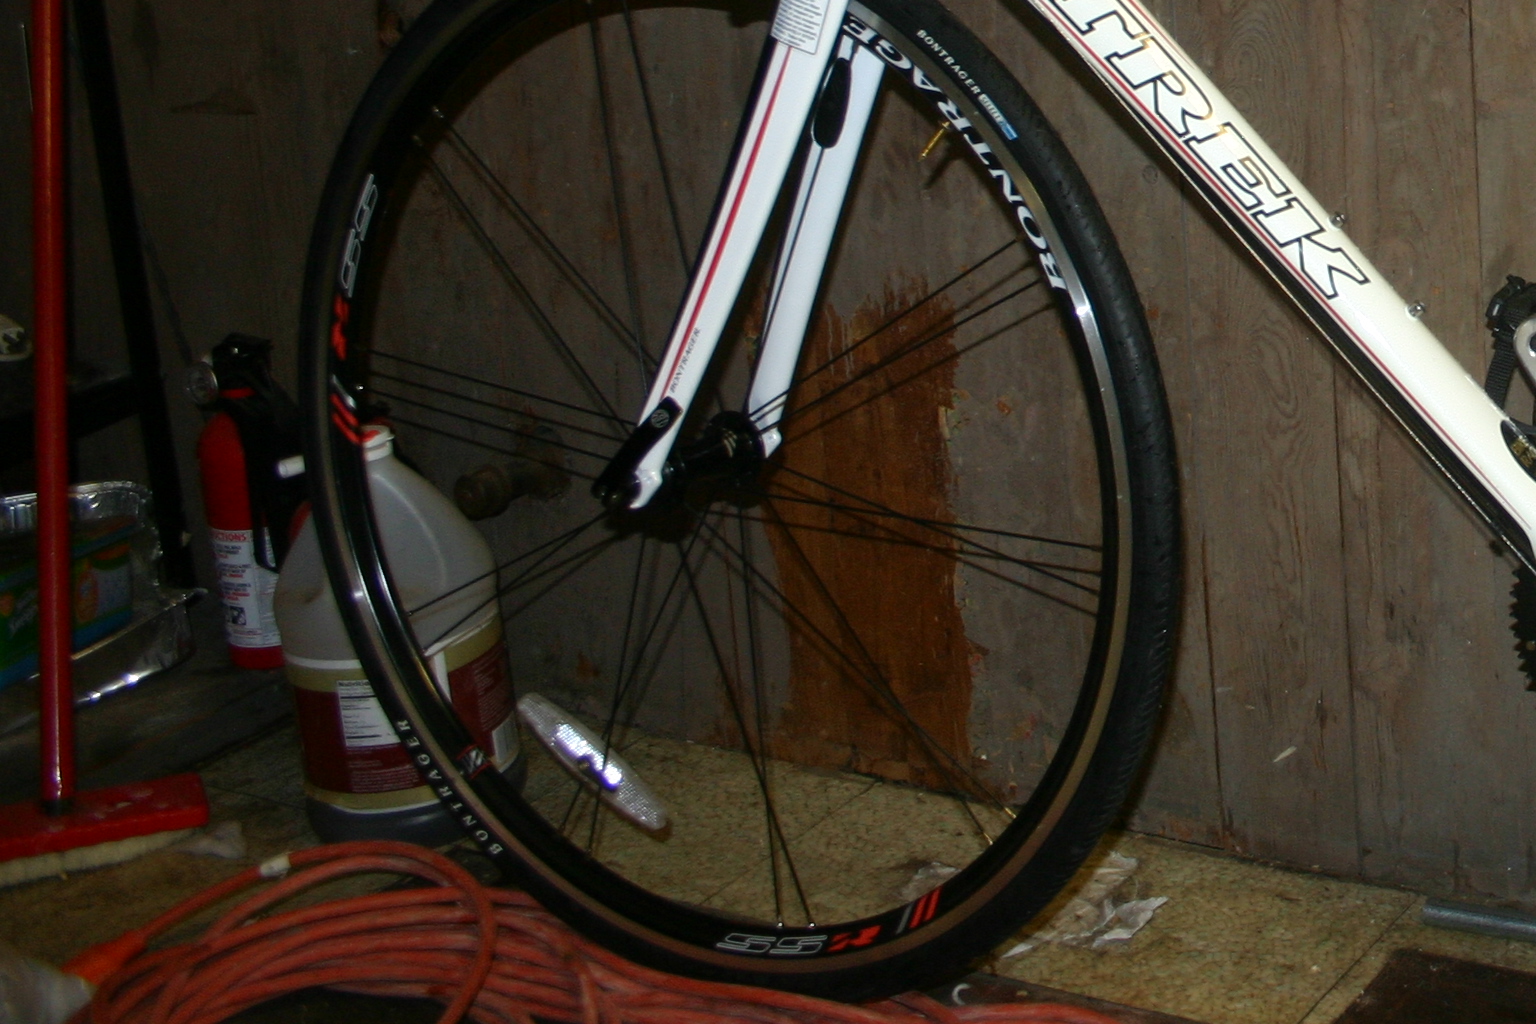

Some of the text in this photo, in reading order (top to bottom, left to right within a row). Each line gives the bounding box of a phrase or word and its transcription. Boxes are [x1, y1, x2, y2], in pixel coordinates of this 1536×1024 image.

[915, 29, 981, 95] BONTRAGER
[842, 15, 1067, 291] BONTRAGE
[395, 719, 505, 856] BONTRAGER
